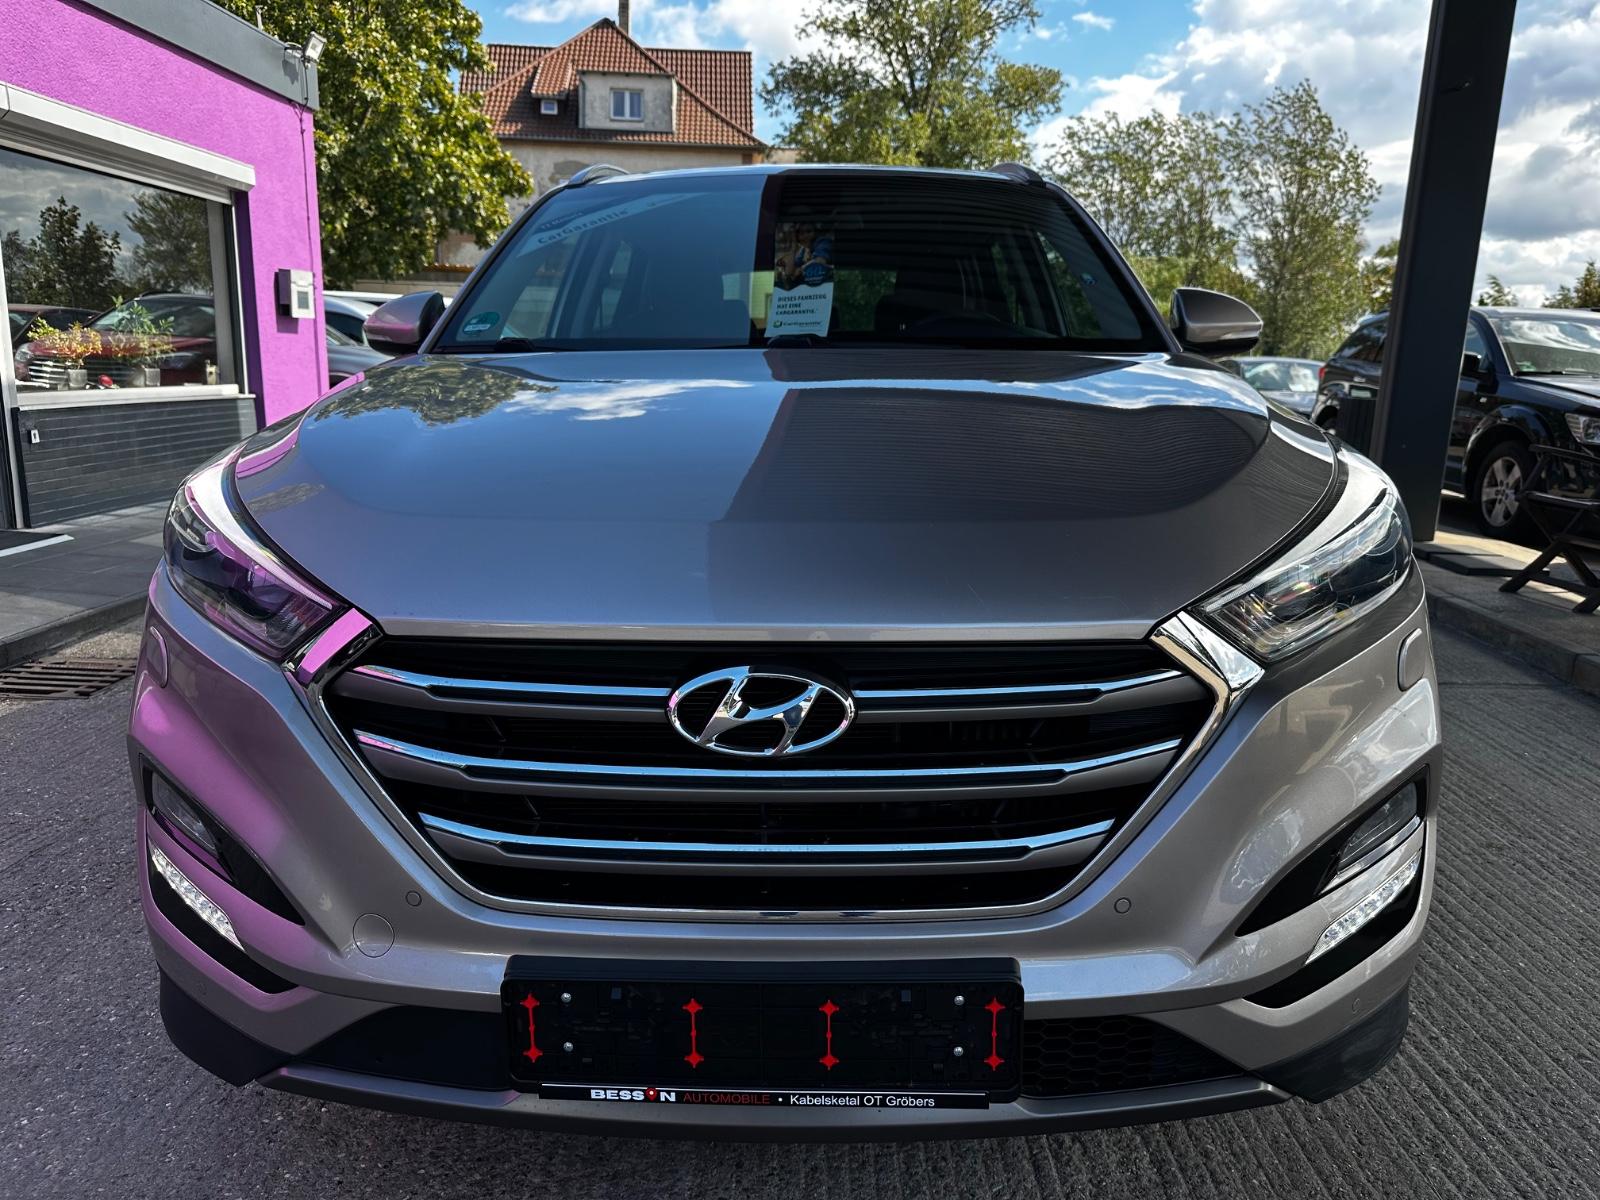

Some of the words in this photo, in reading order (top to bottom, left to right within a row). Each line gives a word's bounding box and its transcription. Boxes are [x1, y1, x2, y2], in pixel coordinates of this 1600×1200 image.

[683, 1092, 770, 1104] AUTOMOBILE
[790, 1094, 860, 1106] Kabelsketal
[863, 1095, 882, 1106] OT
[886, 1095, 935, 1107] Gröbers
